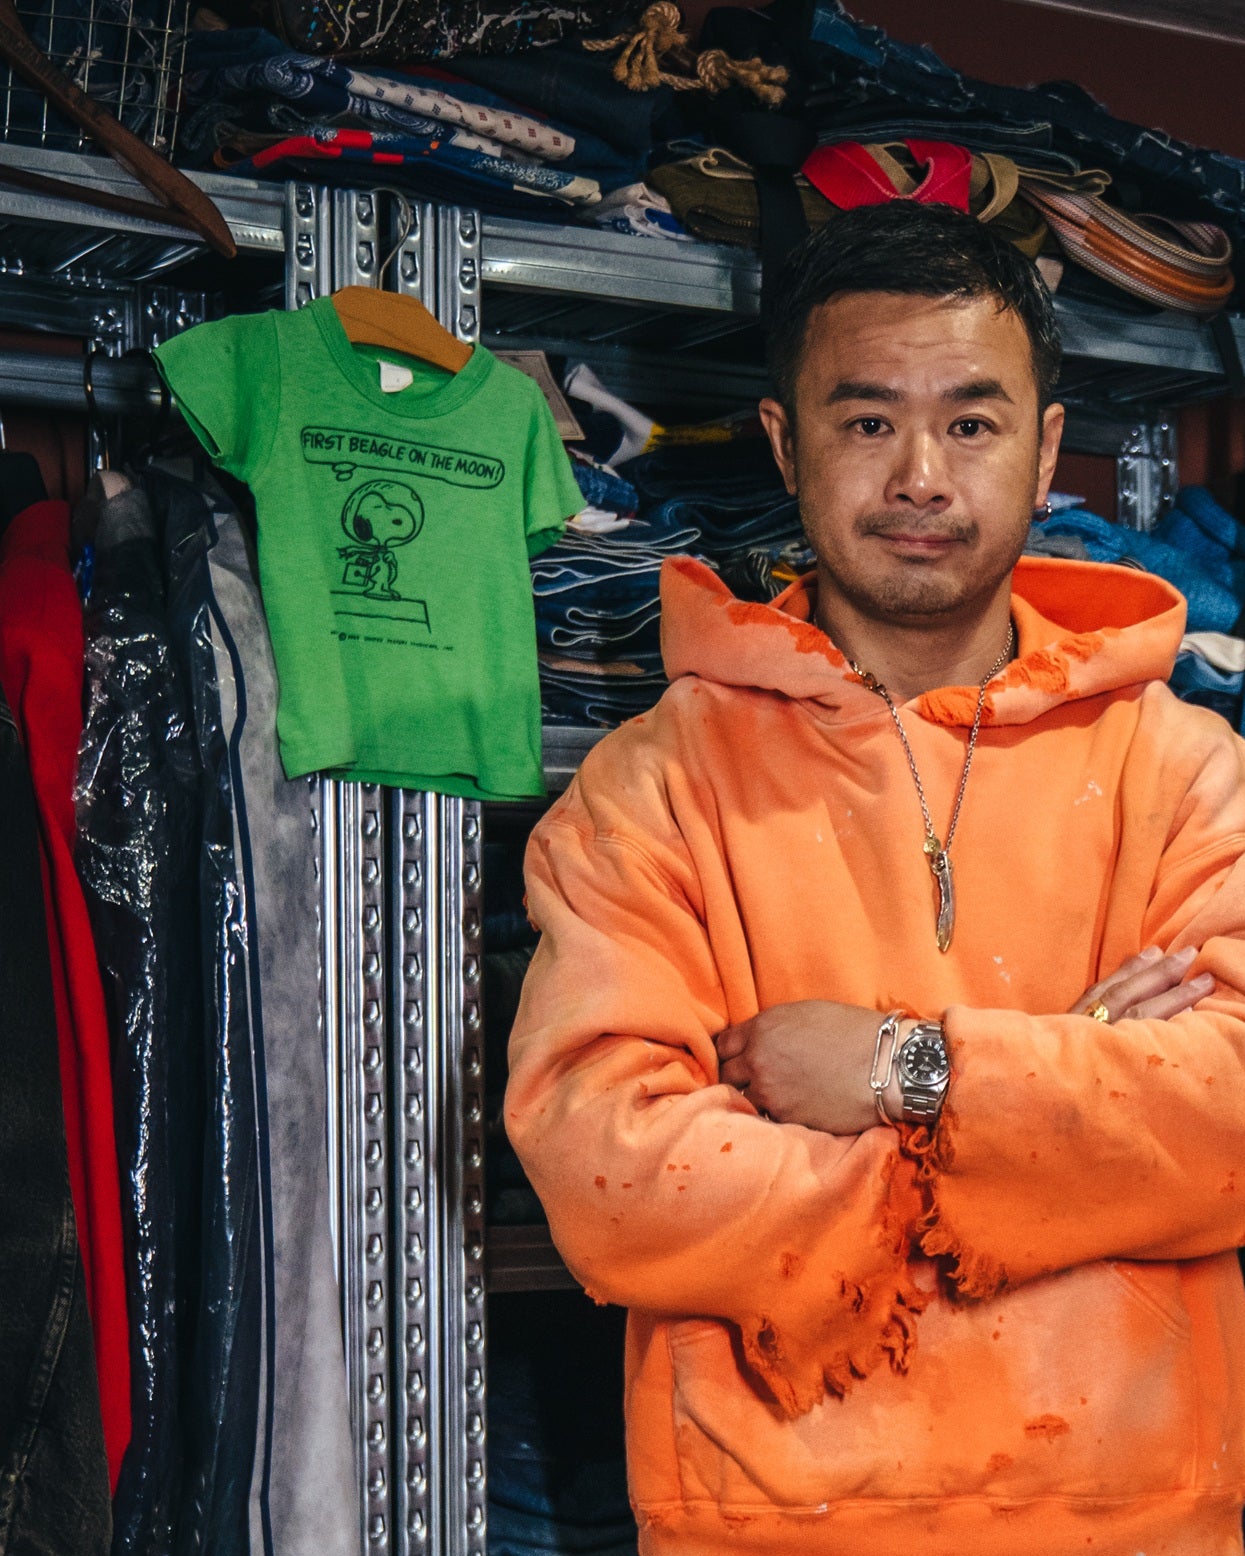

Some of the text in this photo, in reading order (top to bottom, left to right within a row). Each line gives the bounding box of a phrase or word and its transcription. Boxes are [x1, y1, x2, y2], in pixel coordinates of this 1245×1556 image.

[303, 432, 501, 482] FIRST BEAGLE ON THE MOON!
